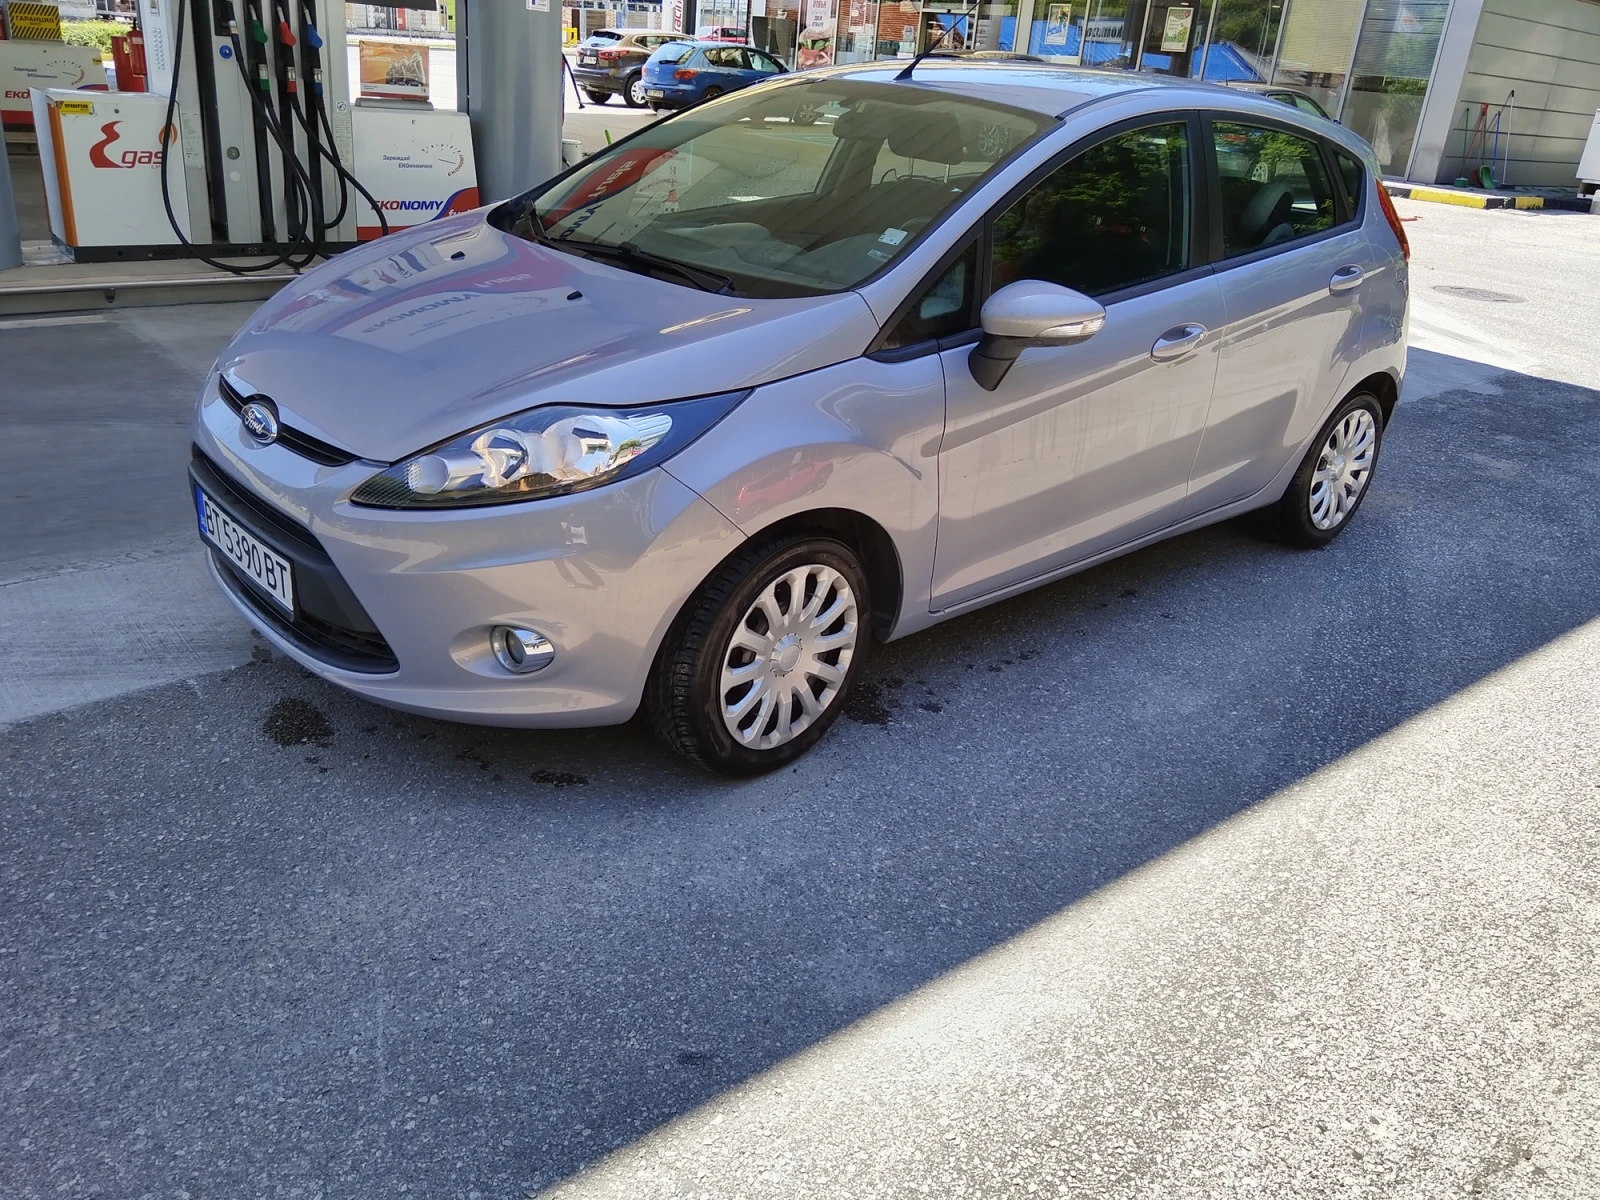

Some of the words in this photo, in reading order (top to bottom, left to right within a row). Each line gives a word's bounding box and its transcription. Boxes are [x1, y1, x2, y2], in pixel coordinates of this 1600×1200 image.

[15, 15, 54, 23] ГАРАНЦИЯ
[673, 0, 685, 32] racin
[382, 154, 411, 162] Зареждай
[244, 408, 265, 435] Ford
